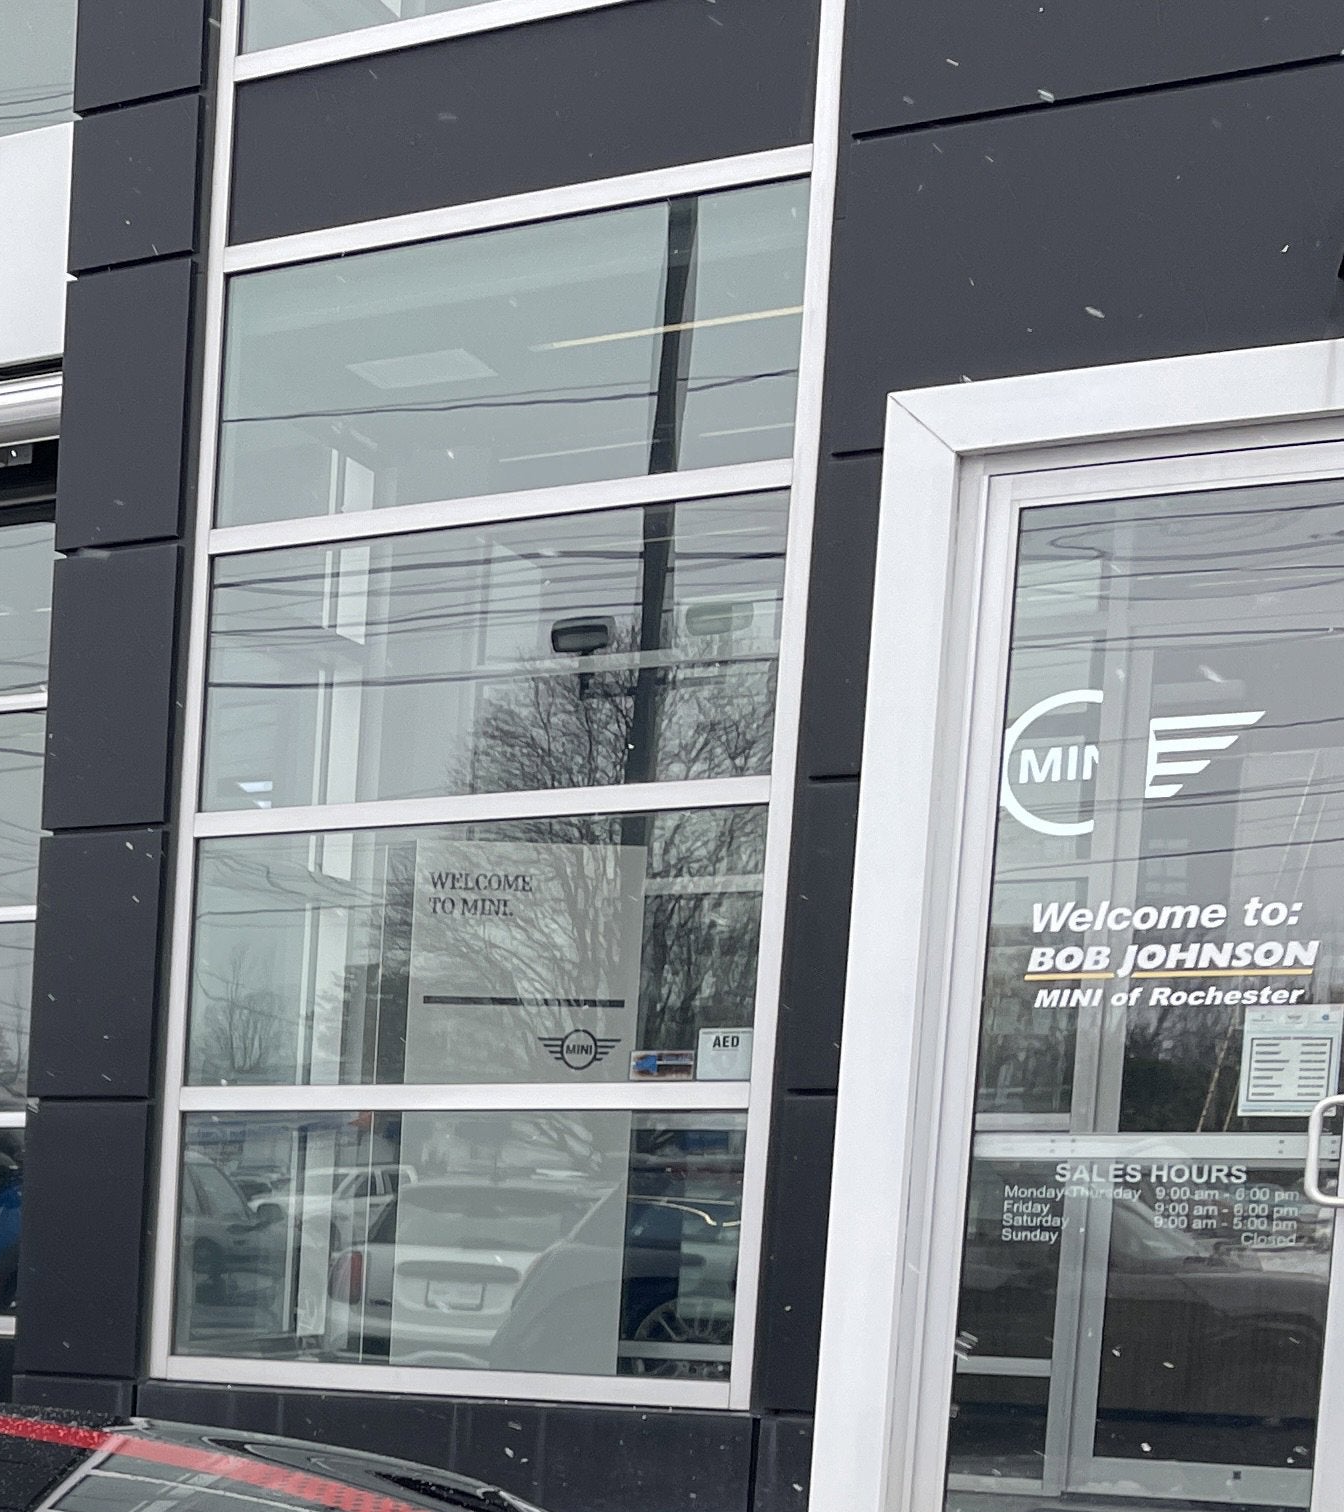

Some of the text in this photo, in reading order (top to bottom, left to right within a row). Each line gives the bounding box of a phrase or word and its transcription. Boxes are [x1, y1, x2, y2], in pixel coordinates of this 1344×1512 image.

[1019, 745, 1100, 784] MIN
[430, 871, 533, 892] WELCOME
[429, 897, 455, 914] TO
[1032, 897, 1303, 933] Welcome to:
[1027, 940, 1320, 978] BOB JOHNSON
[1034, 986, 1304, 1008] MINI of Rochester
[565, 1043, 593, 1056] MINI
[713, 1036, 740, 1048] AED
[1054, 1164, 1247, 1184] SALES HOURS
[1155, 1187, 1190, 1200] 9:00
[1194, 1190, 1219, 1200] am
[1235, 1188, 1269, 1200] 6:00
[1274, 1190, 1300, 1203] pm
[1003, 1200, 1050, 1215] Friday
[1154, 1203, 1189, 1216] 9:00
[1193, 1205, 1218, 1216] am
[1273, 1206, 1299, 1219] pm
[1002, 1213, 1069, 1229] Saturday
[1153, 1216, 1188, 1229] 9:00
[1192, 1218, 1217, 1229] am
[1232, 1216, 1267, 1230] 5:00
[1272, 1220, 1298, 1232] pm
[1001, 1228, 1297, 1246] Sunday Closed
